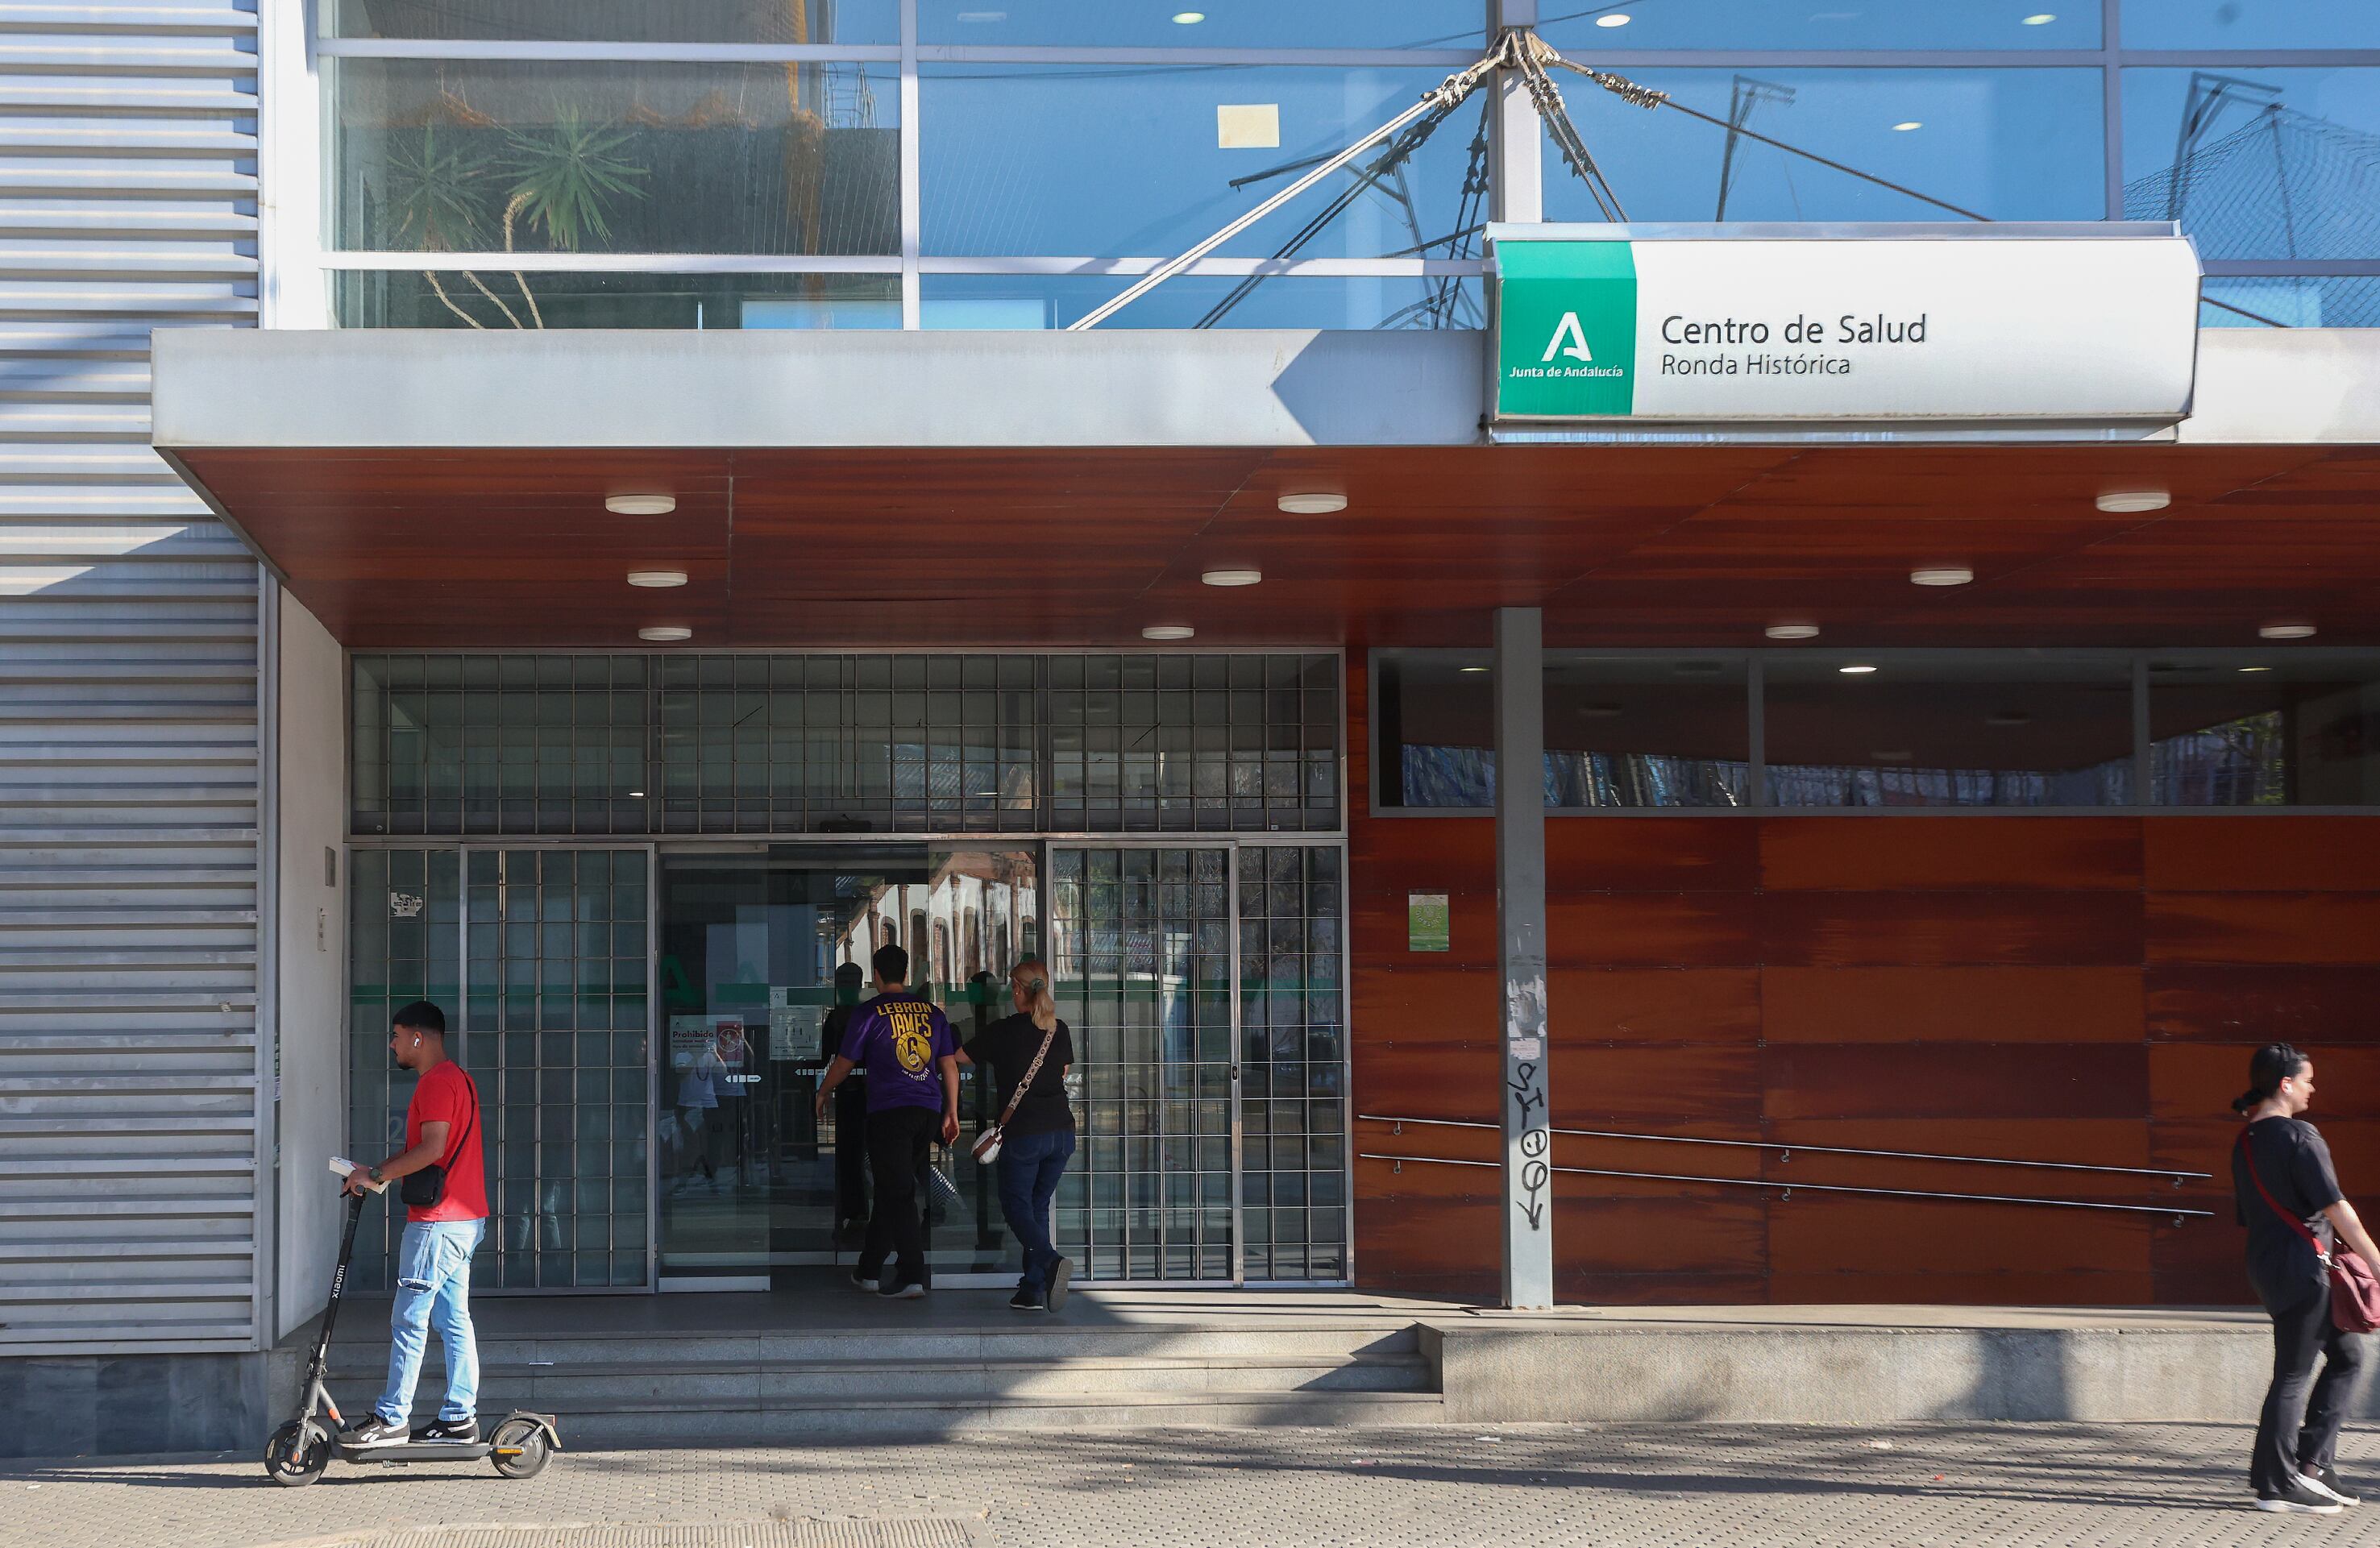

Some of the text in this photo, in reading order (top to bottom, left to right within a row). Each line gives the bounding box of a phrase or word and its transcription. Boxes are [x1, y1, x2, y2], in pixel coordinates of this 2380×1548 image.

[1662, 313, 1926, 344] Centro de Salud
[1509, 365, 1623, 378] Junta de Andalucía
[1662, 353, 1850, 375] Ronda Histórica
[875, 1002, 933, 1016] LEBRON
[672, 1030, 714, 1039] Prohibido
[889, 1013, 932, 1040] JAMES
[331, 1264, 346, 1299] xiaomi
